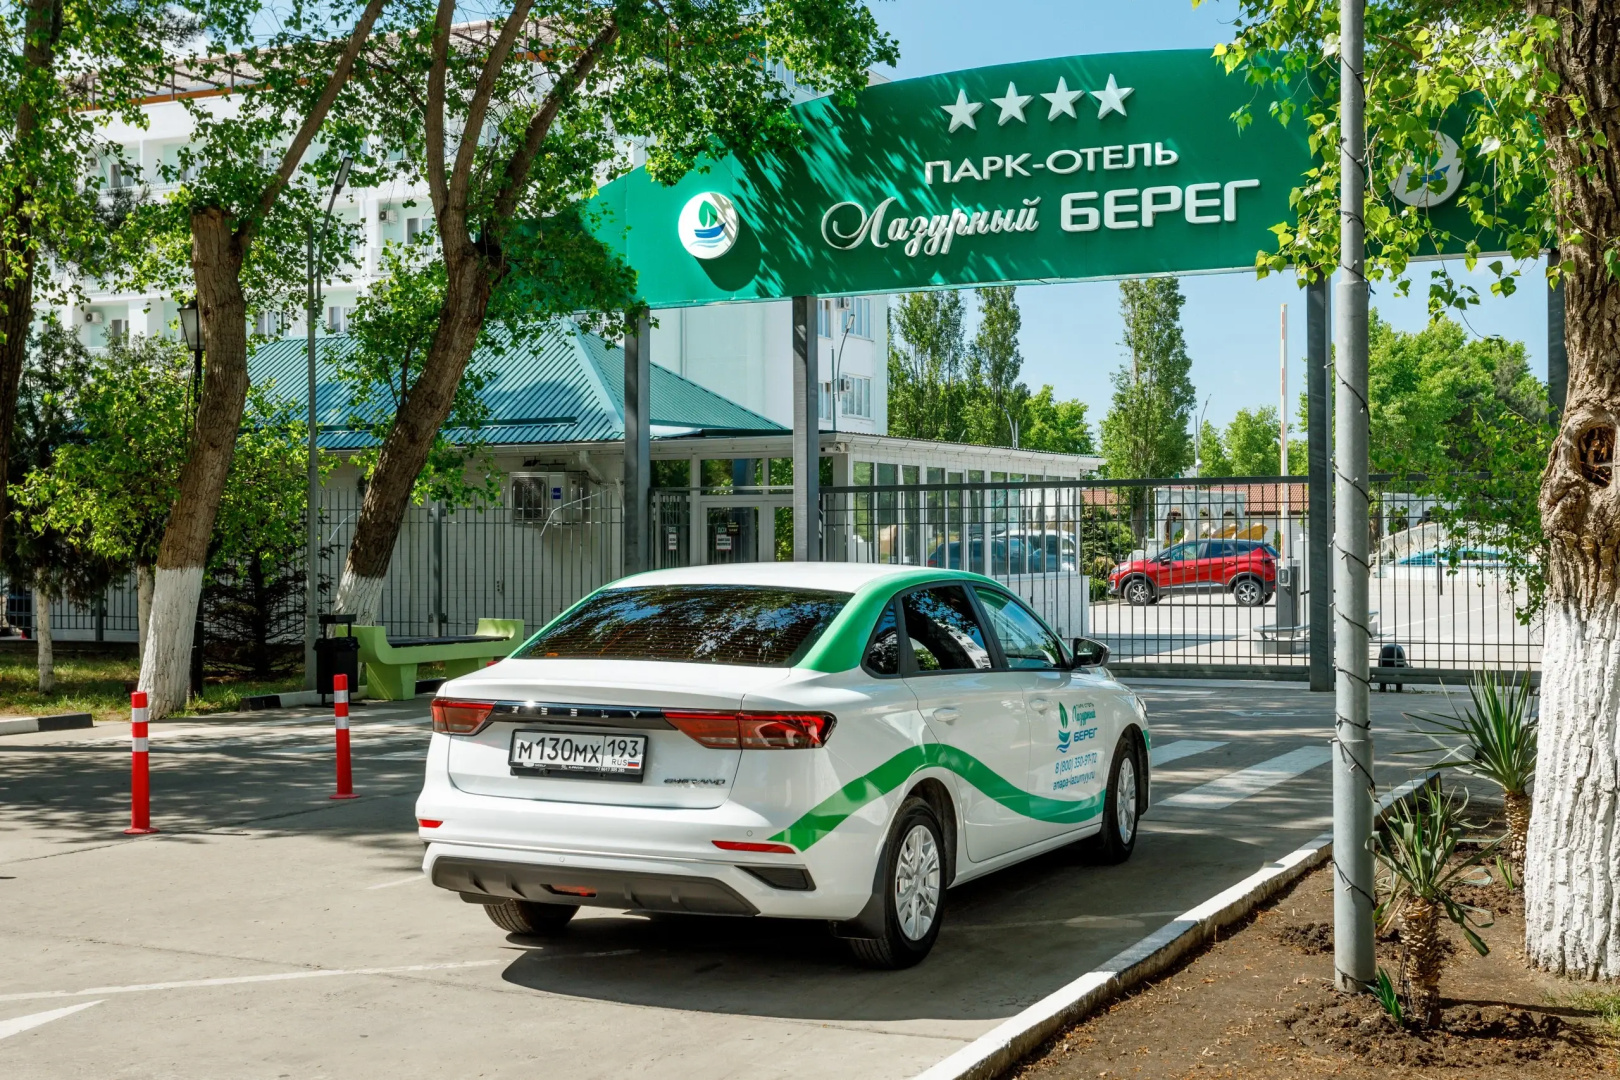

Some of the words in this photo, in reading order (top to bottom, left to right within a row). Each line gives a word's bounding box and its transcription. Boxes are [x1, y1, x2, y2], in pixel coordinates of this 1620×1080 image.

[924, 142, 1179, 185] ПАРК-ОТЕЛЬ
[821, 196, 1041, 257] Лазурный
[1060, 179, 1260, 232] БЕРЕГ
[1073, 727, 1098, 742] БЕРЕГ
[607, 739, 639, 758] 193
[611, 759, 628, 767] RUS
[1055, 762, 1060, 774] 8
[1059, 758, 1074, 775] (800)
